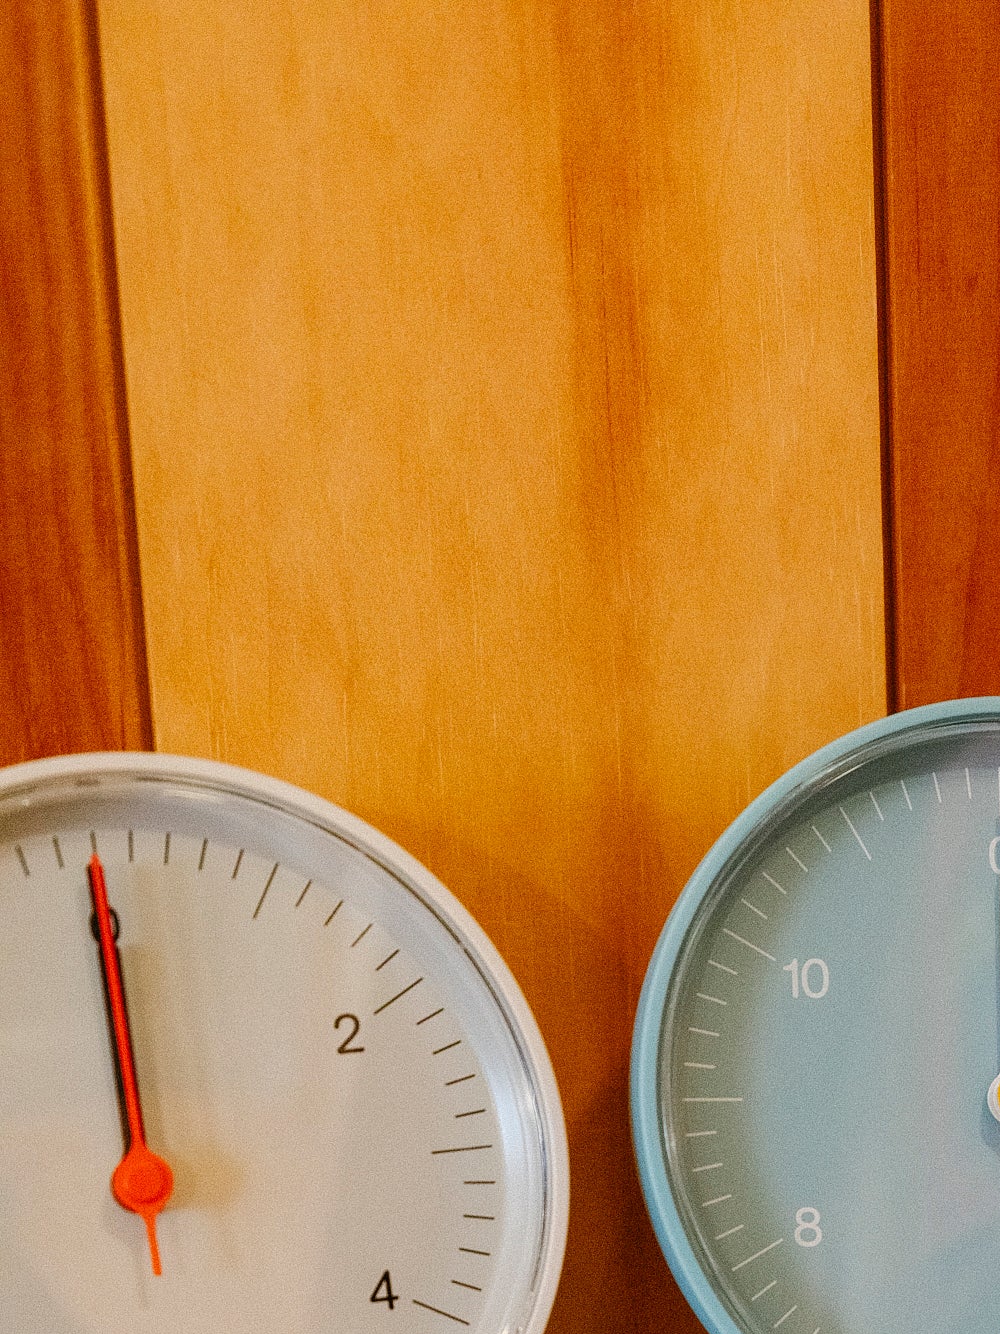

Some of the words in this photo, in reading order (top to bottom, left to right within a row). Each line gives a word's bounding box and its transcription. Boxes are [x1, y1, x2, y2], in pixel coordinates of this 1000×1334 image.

[783, 958, 830, 999] 10
[333, 1013, 366, 1055] 2
[794, 1206, 823, 1248] 8
[369, 1270, 399, 1310] 4
